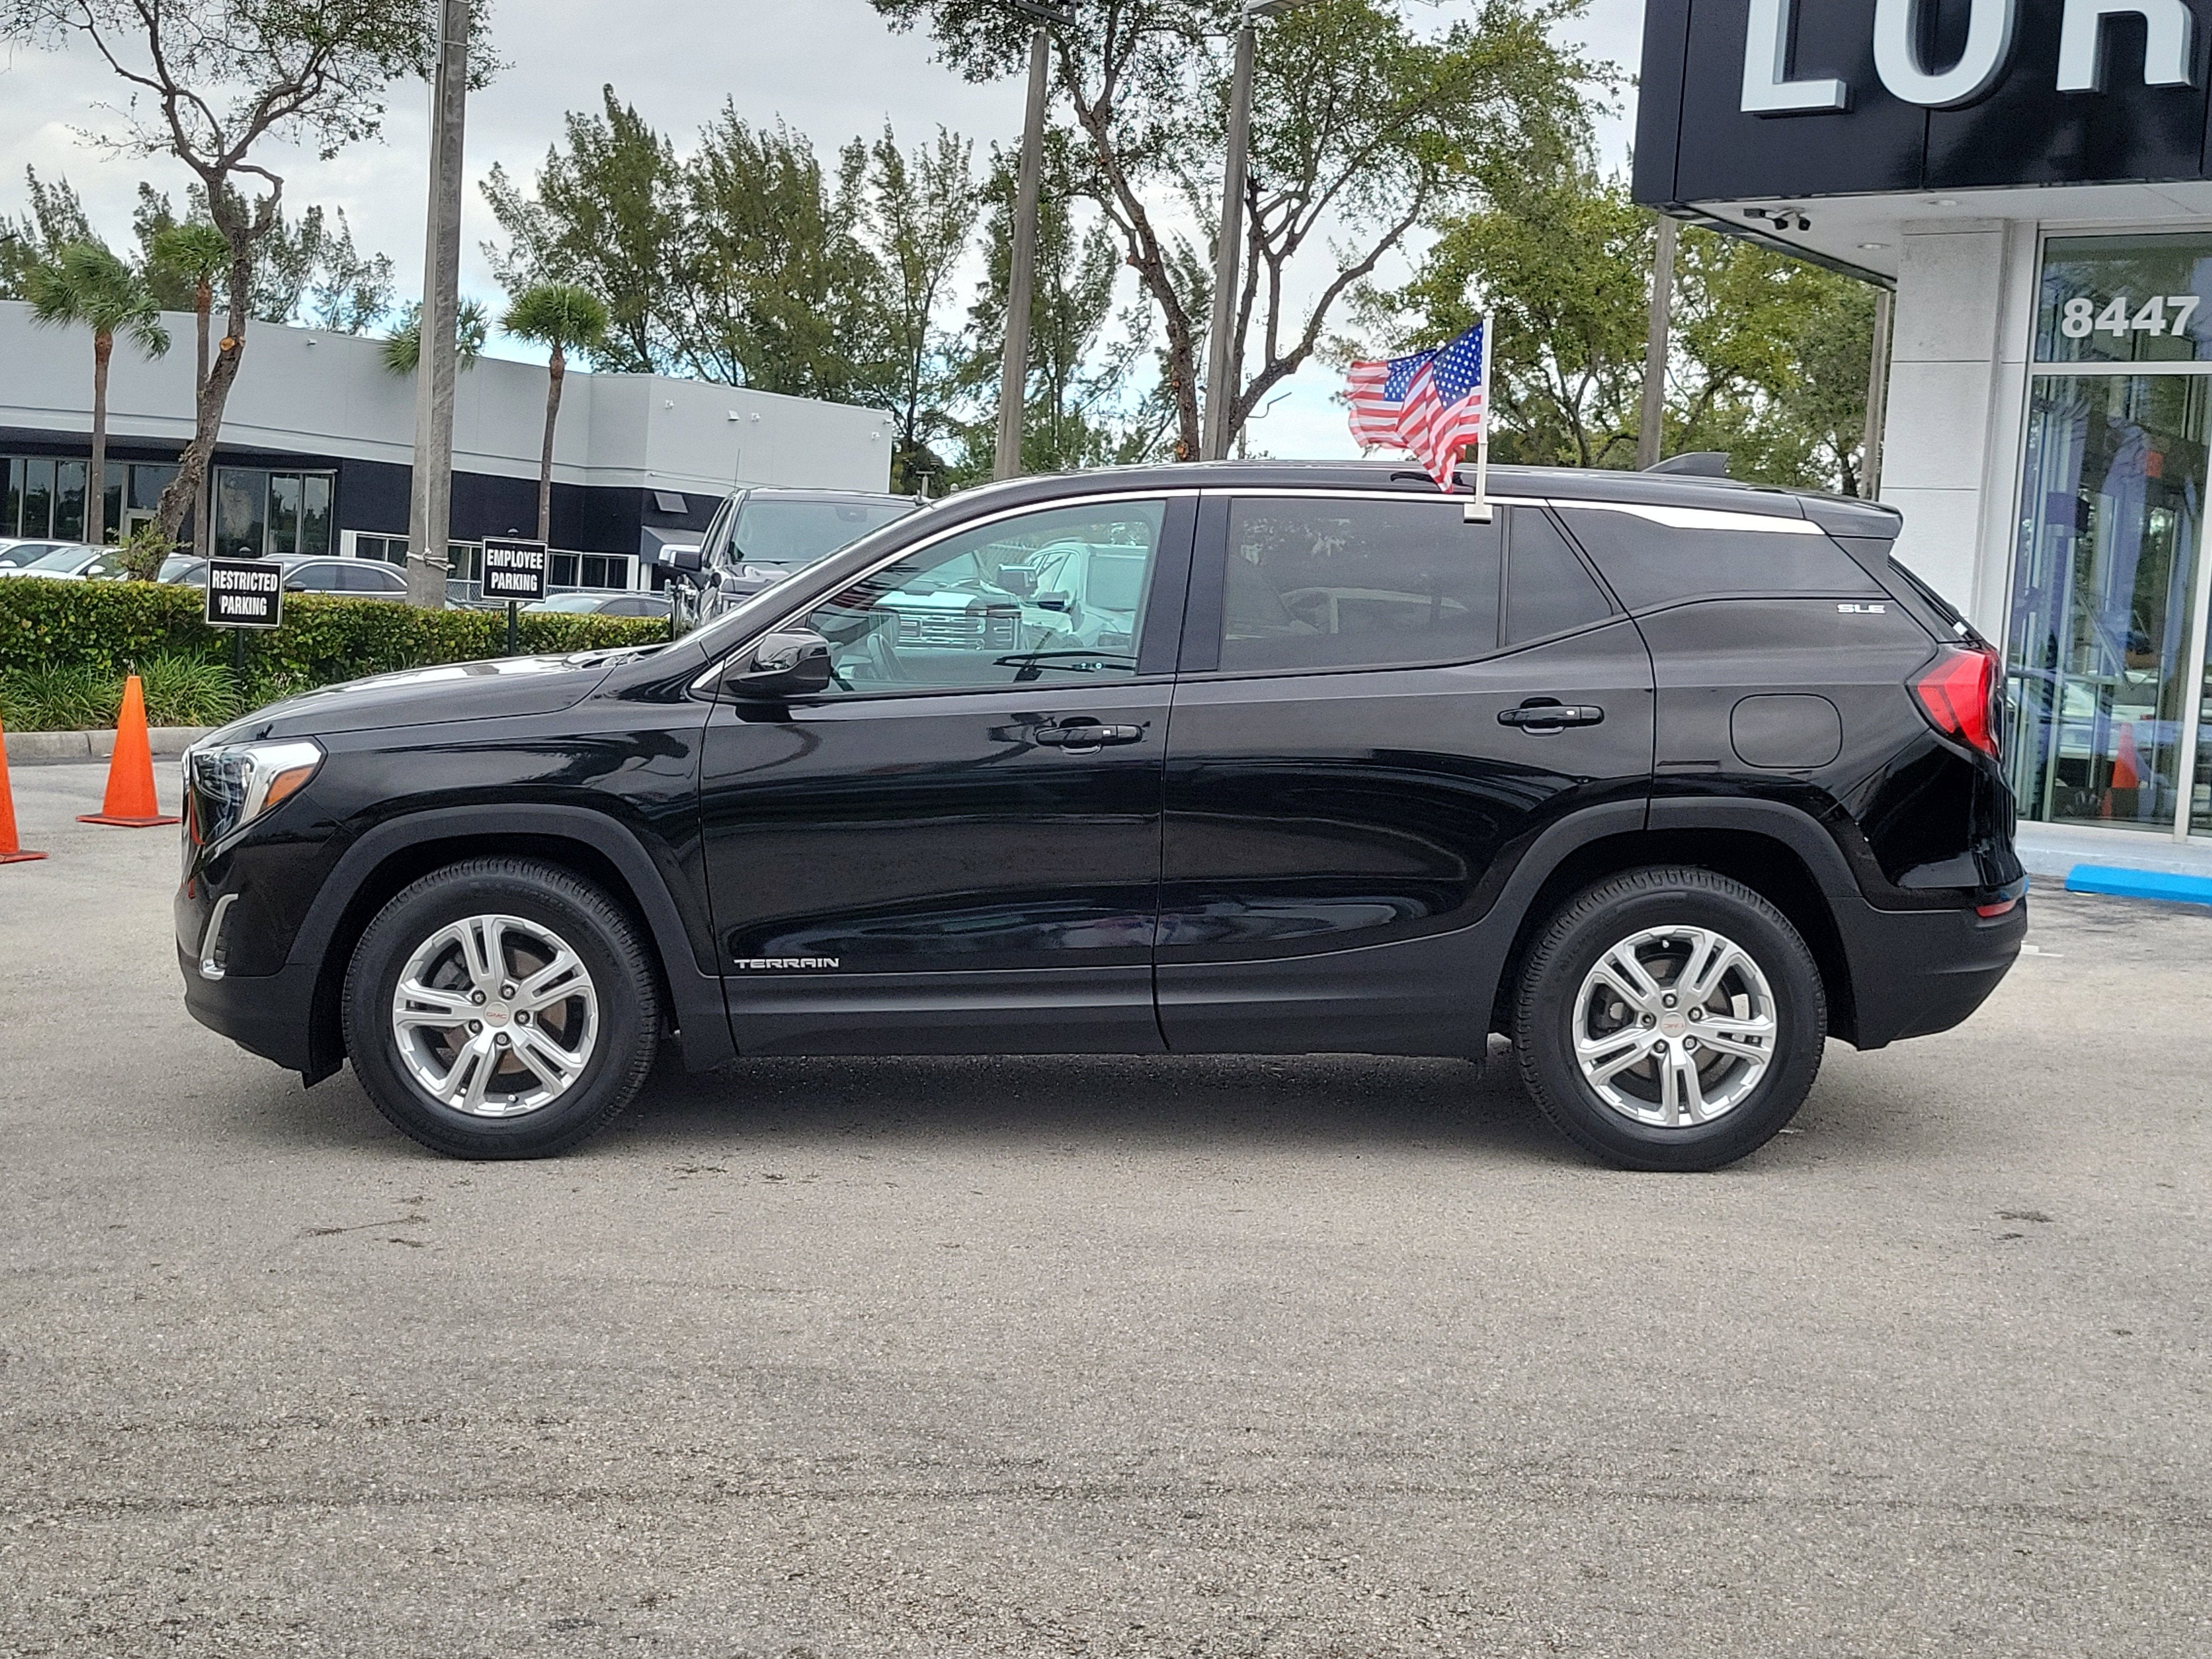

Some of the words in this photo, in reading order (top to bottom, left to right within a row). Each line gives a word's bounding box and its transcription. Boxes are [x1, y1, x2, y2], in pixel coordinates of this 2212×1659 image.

[2061, 296, 2200, 338] 8447
[487, 549, 543, 570] EMPLOYEE
[212, 569, 278, 592] RESTRICTED
[490, 572, 538, 591] PARKING
[220, 595, 267, 616] PARKING
[1837, 604, 1886, 614] SLE
[733, 958, 839, 969] TERRAIN
